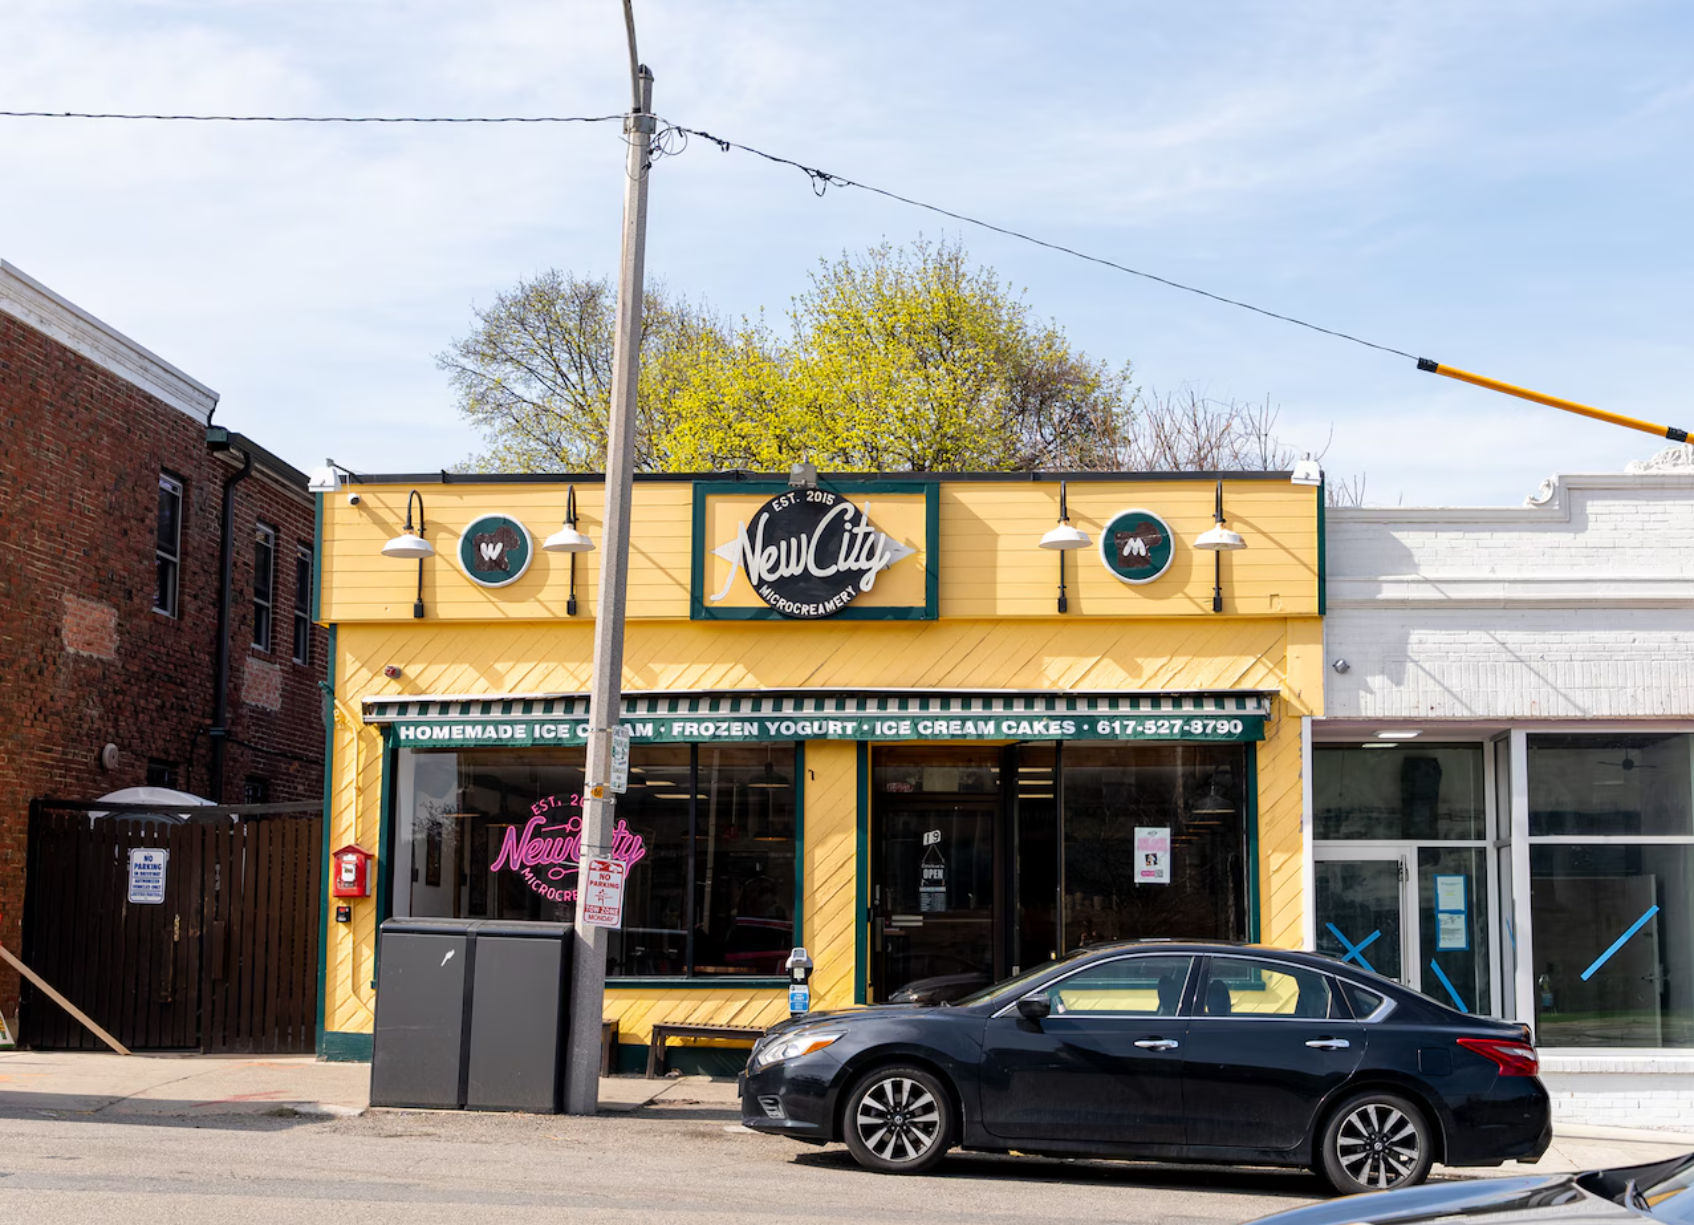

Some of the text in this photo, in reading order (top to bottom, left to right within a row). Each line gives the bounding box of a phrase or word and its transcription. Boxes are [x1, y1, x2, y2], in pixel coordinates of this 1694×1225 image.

[771, 491, 835, 512] EST. 2015
[759, 585, 857, 616] MICROCREAMERY
[399, 724, 527, 740] HOMEMADE
[533, 724, 570, 738] ICE
[576, 722, 654, 738] CAM
[671, 721, 759, 737] FROZEN
[764, 720, 856, 737] YOGURT
[874, 720, 912, 735] ICE
[917, 720, 995, 735] CREAM
[1001, 720, 1076, 735] CAKES
[1096, 719, 1243, 735] 617-527-8790
[599, 873, 611, 882] NO
[923, 868, 943, 879] OPEN
[589, 880, 620, 890] PARKING
[602, 906, 619, 916] ZONE
[588, 914, 614, 922] MONDAY
